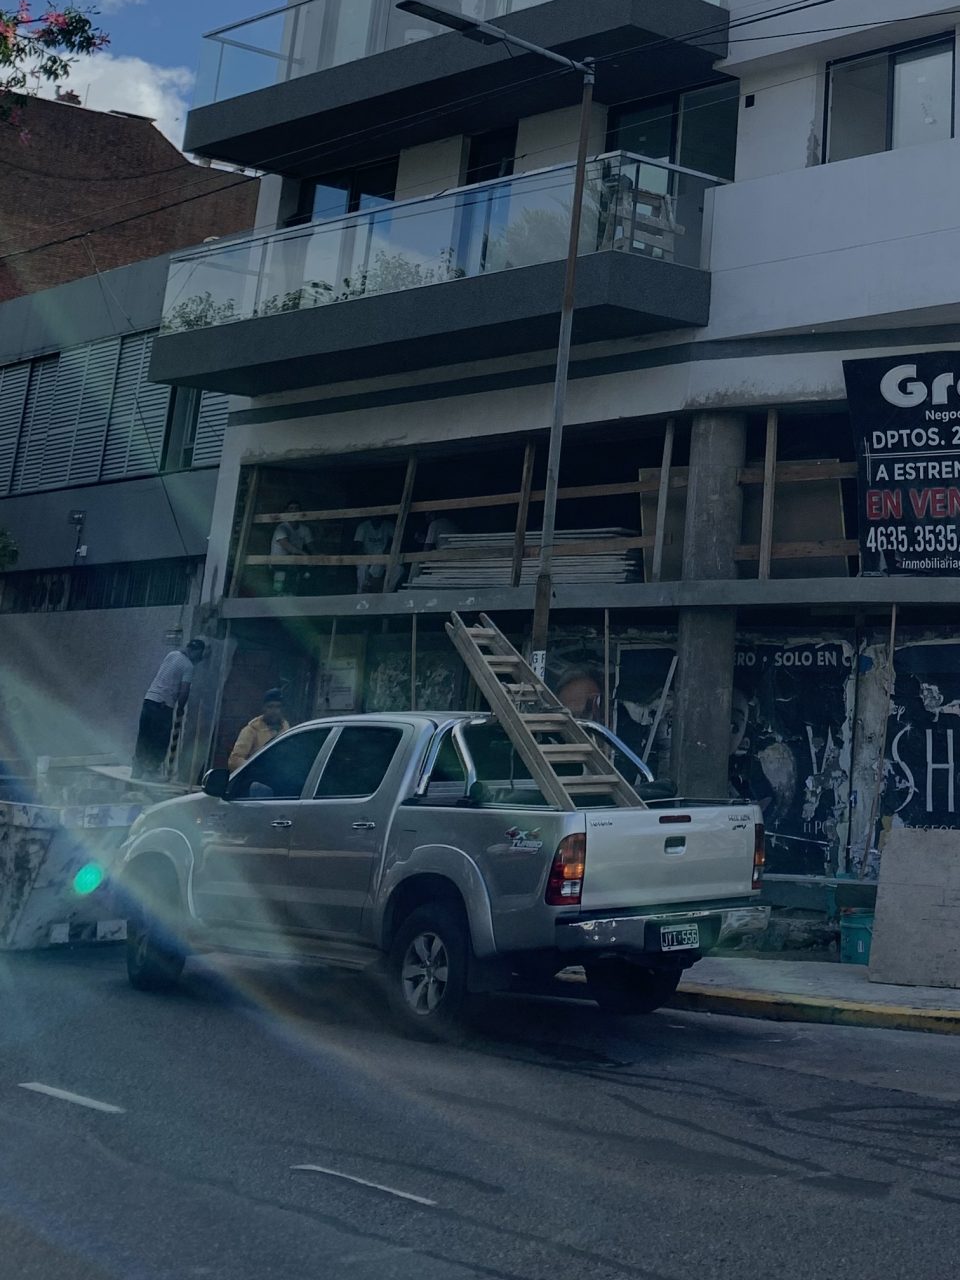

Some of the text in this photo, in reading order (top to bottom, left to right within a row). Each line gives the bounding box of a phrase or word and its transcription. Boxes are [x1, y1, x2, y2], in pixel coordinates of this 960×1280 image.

[873, 427, 946, 449] DPTOS.
[876, 464, 890, 481] A
[867, 489, 903, 520] EN
[774, 651, 813, 667] SOLO
[817, 651, 837, 667] EN
[682, 930, 698, 944] 556
